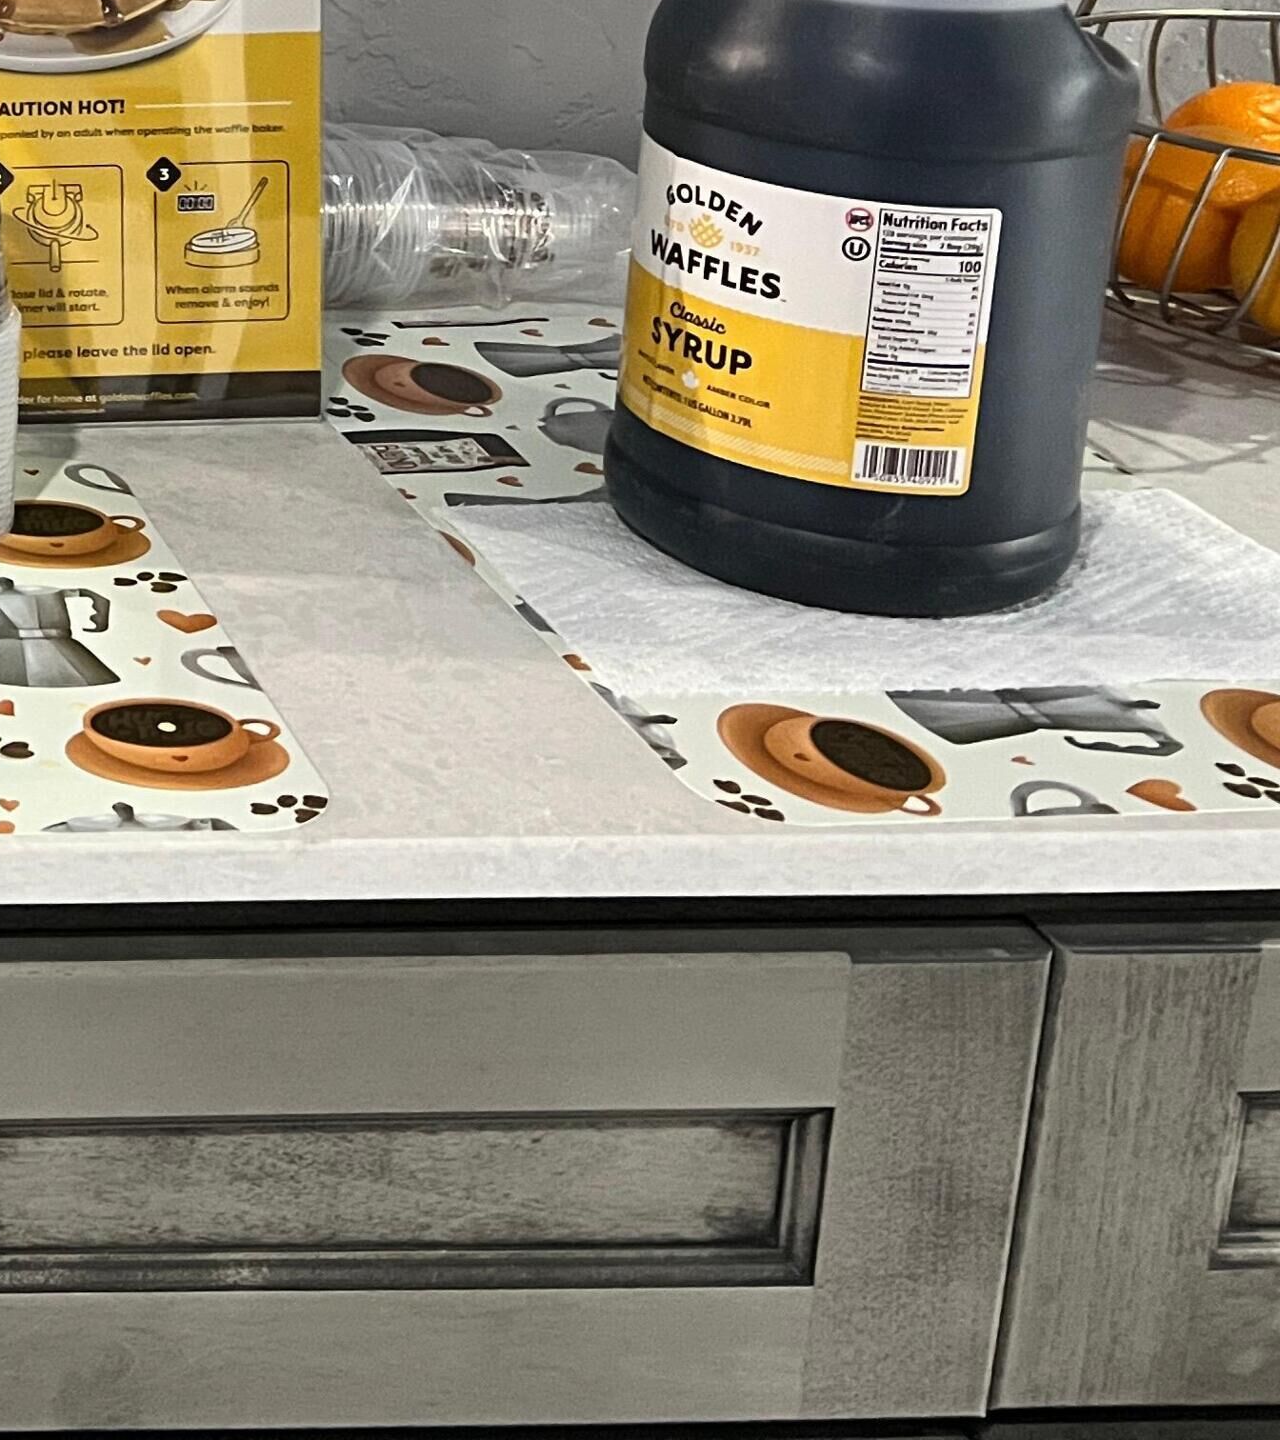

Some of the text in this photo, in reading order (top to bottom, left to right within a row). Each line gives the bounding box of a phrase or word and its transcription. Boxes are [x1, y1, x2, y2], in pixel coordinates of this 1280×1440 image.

[78, 99, 125, 115] HOT!
[41, 129, 54, 140] by
[193, 124, 213, 134] the
[159, 168, 170, 181] 3
[666, 183, 763, 236] GOLDEN
[883, 212, 947, 231] Nutrition
[951, 217, 989, 231] Facts
[651, 228, 781, 299] WAFFLES
[959, 260, 982, 273] 100
[10, 289, 36, 298] lose
[38, 288, 53, 298] lid
[56, 287, 66, 298] &
[165, 285, 200, 294] When
[17, 303, 45, 312] imer
[221, 298, 231, 307] &
[669, 301, 726, 335] Classic
[23, 343, 216, 362] please leave the lid open.
[651, 316, 753, 375] SYRUP
[53, 394, 83, 404] home
[85, 393, 97, 403] at
